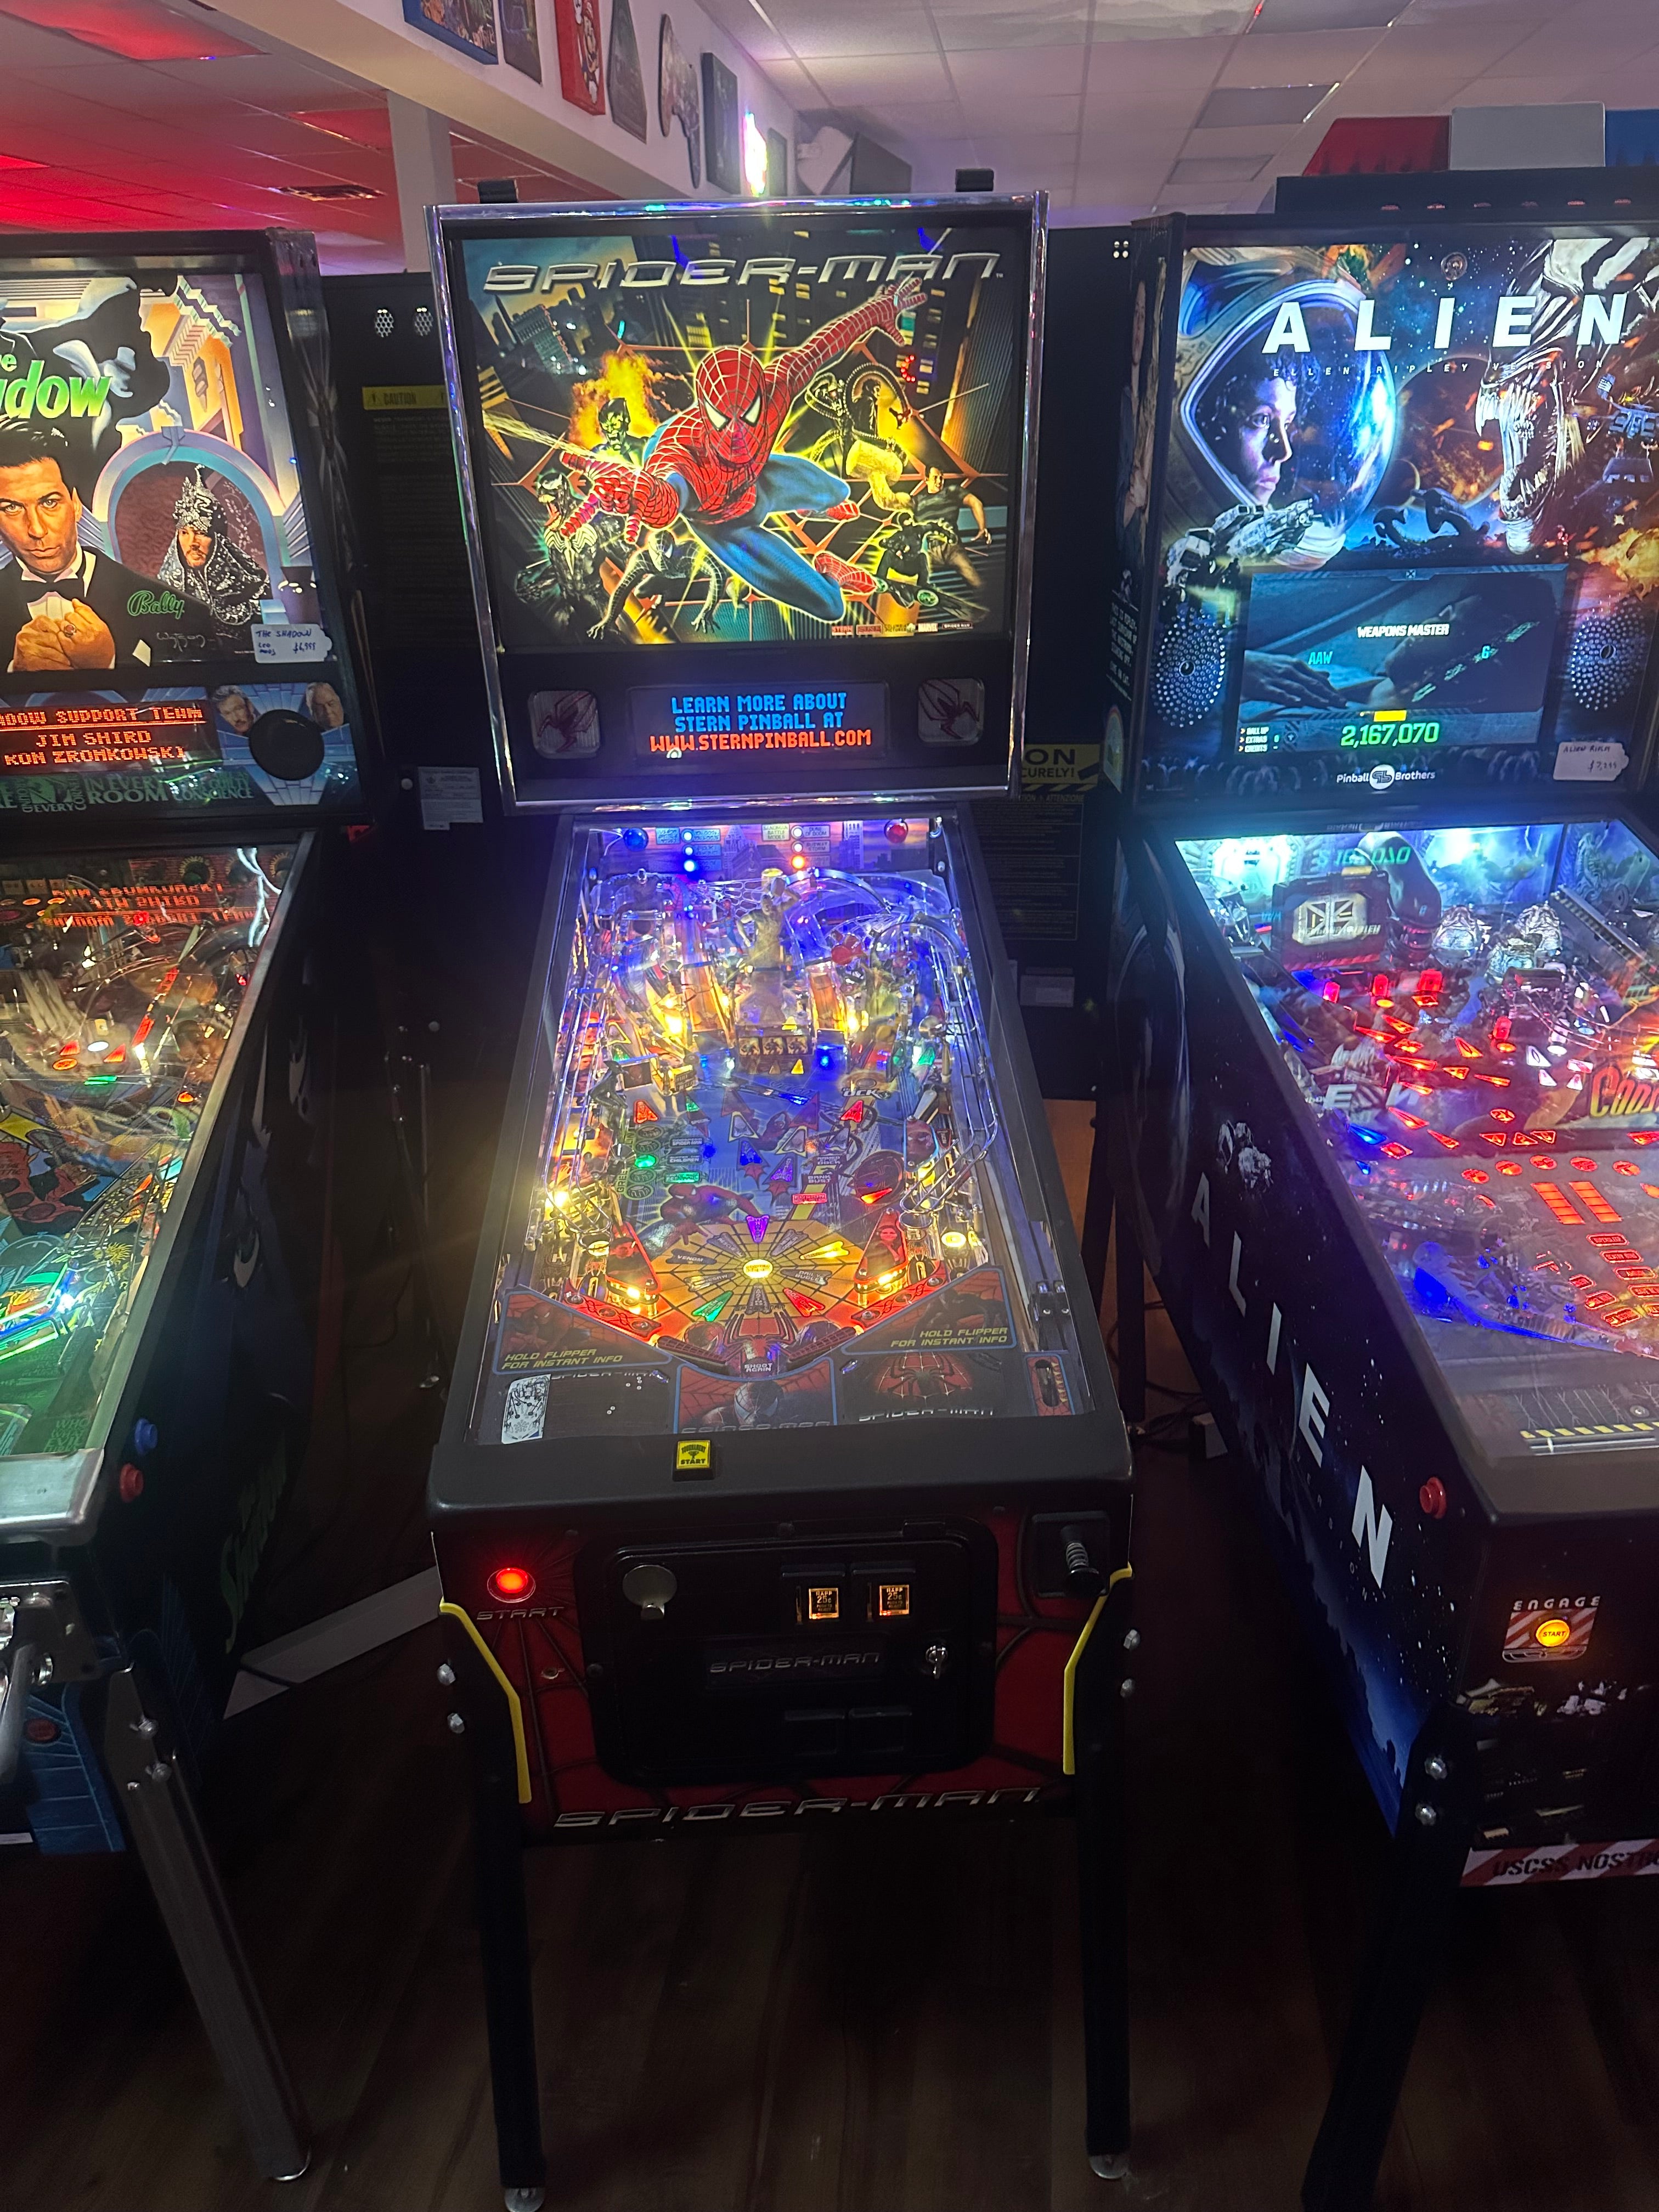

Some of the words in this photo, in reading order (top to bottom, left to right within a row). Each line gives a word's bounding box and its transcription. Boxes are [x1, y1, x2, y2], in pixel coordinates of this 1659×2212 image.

[483, 252, 1000, 291] SPIDER-MAN
[1262, 294, 1627, 354] ALIEN
[1273, 365, 1350, 376] ELLEN
[1376, 363, 1470, 374] RIPLEY
[1492, 360, 1603, 371] VERSION
[0, 359, 113, 419] dow
[127, 590, 185, 619] Bally
[276, 629, 312, 637] SHADOW
[1358, 625, 1407, 638] WEAPONS
[1408, 623, 1450, 636] MASTER
[1308, 651, 1333, 665] AAW
[672, 696, 730, 713] LEARN
[737, 695, 786, 712] MORE
[793, 692, 847, 710] ABOUT
[55, 708, 138, 724] SUPPORT
[149, 707, 203, 720] TEAM
[675, 715, 731, 732] STERN
[738, 713, 816, 731] PINBALL
[823, 712, 844, 729] AT
[36, 733, 77, 747] JIM
[83, 730, 151, 746] SHIRD
[650, 730, 872, 752] WWW.STERNPINBALL.COM
[1341, 722, 1440, 748] 2,167,070
[1336, 772, 1369, 783] Pinball
[1395, 771, 1436, 781] Brothers
[89, 788, 168, 804] ROOM
[919, 1329, 952, 1338] HOLD
[958, 1327, 1008, 1336] FLIPPER
[891, 1339, 916, 1347] FOR
[921, 1337, 973, 1346] INSTANT
[979, 1335, 1007, 1344] INFO
[502, 1362, 528, 1370] FOR
[533, 1358, 586, 1368] INSTANT
[593, 1355, 623, 1363] INFO
[505, 1352, 538, 1362] HOLD
[544, 1349, 597, 1358] FLIPPER
[1513, 1596, 1601, 1611] ENGAGE
[477, 1606, 565, 1620] START
[710, 1652, 880, 1673] SPIDER-MAN
[553, 1787, 1041, 1827] SPIDER-MAN
